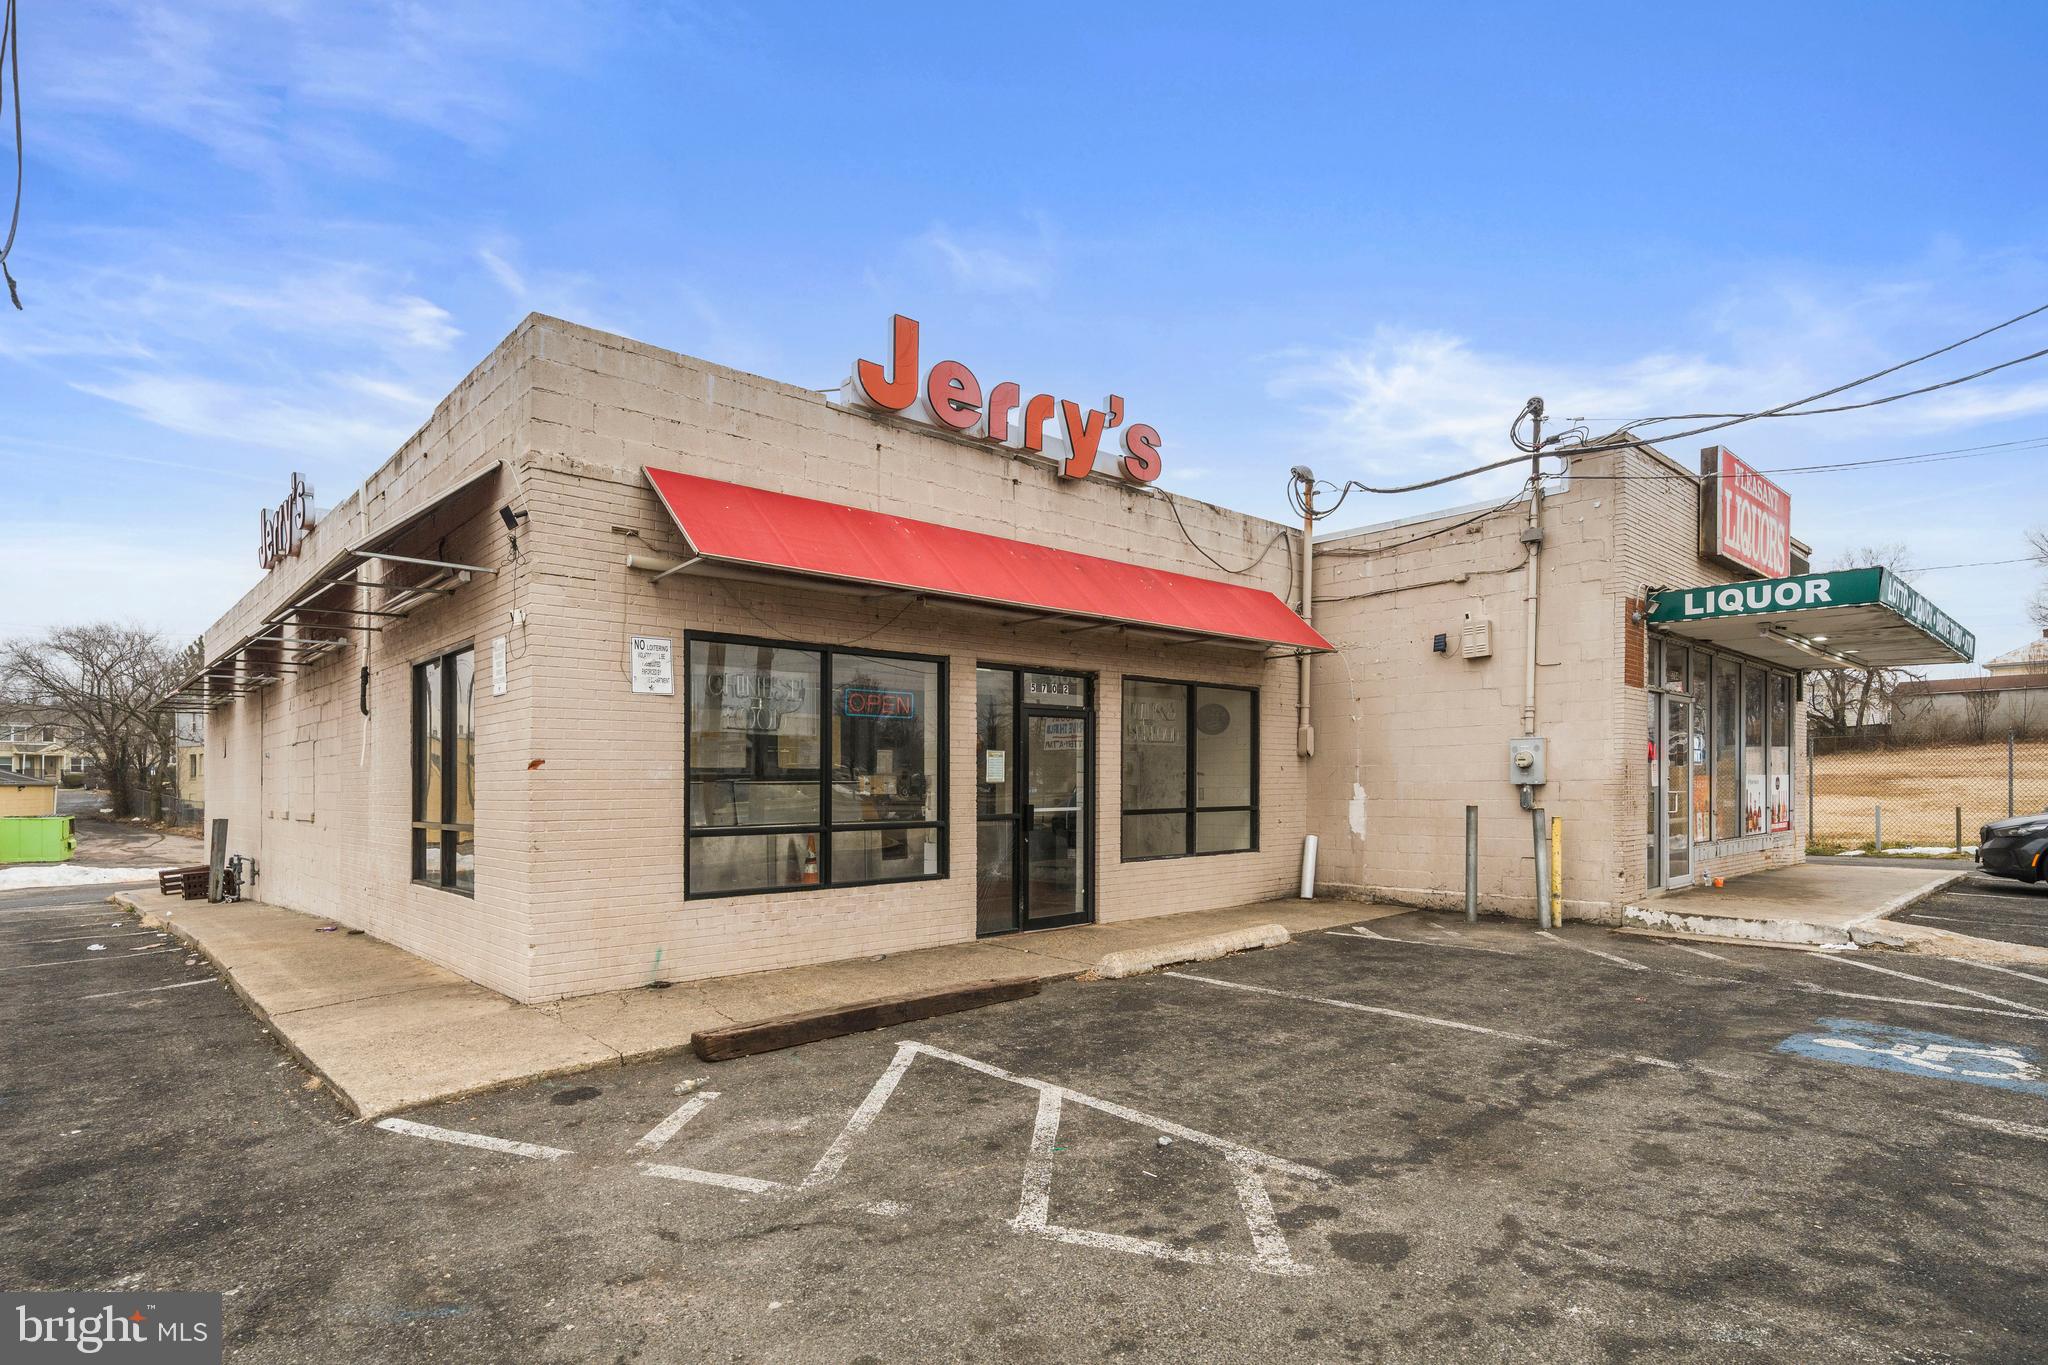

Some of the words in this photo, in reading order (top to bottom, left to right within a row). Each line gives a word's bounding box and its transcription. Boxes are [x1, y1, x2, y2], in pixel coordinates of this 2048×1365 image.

[853, 313, 1163, 483] Jerry's
[1734, 462, 1779, 513] PLEASANT
[259, 472, 306, 570] Jerry's
[1725, 488, 1785, 575] LIQUORS
[1684, 578, 1832, 615] LIQUOR
[1888, 577, 1909, 612] LOTTO
[1911, 594, 1933, 627] LIQUOR
[634, 639, 646, 651] NO
[647, 644, 669, 652] LOITERING
[848, 693, 911, 715] OPEN
[1030, 683, 1069, 694] 5702
